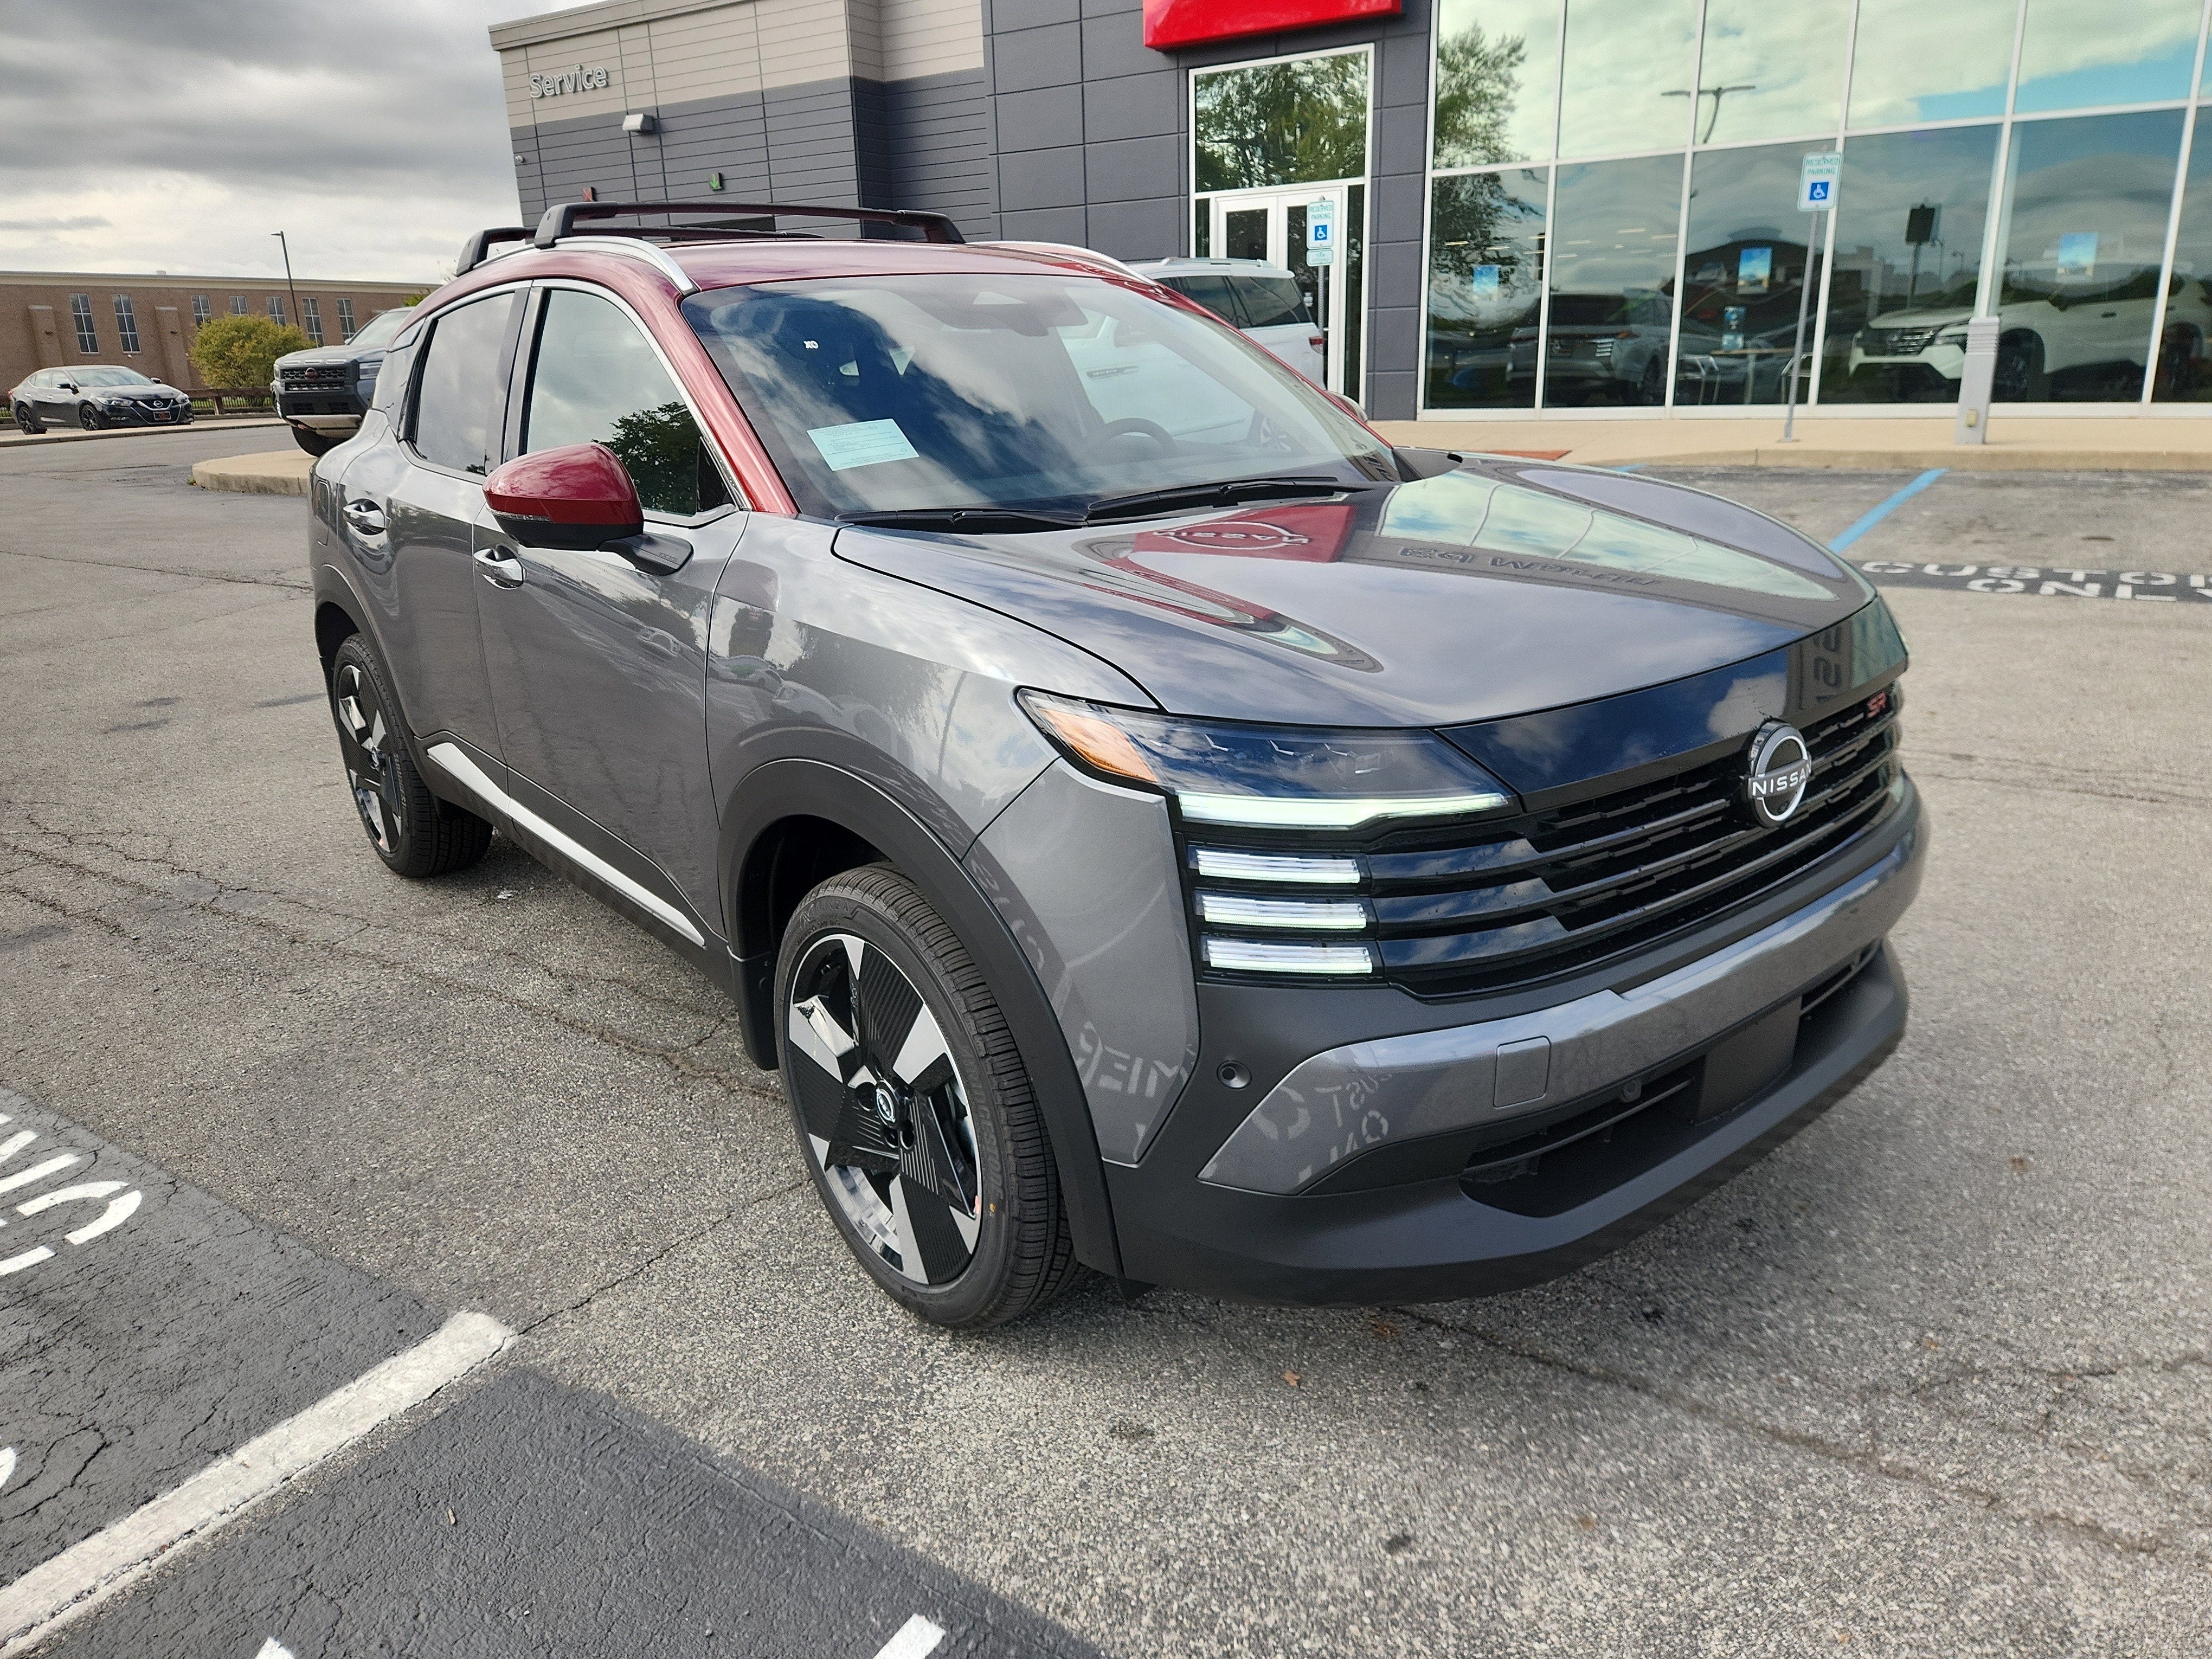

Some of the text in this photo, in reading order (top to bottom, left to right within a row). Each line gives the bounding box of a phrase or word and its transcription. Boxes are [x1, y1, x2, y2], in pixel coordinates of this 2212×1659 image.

[529, 63, 608, 99] Service
[1806, 157, 1838, 166] RESERVED
[1752, 759, 1812, 797] NISSAN
